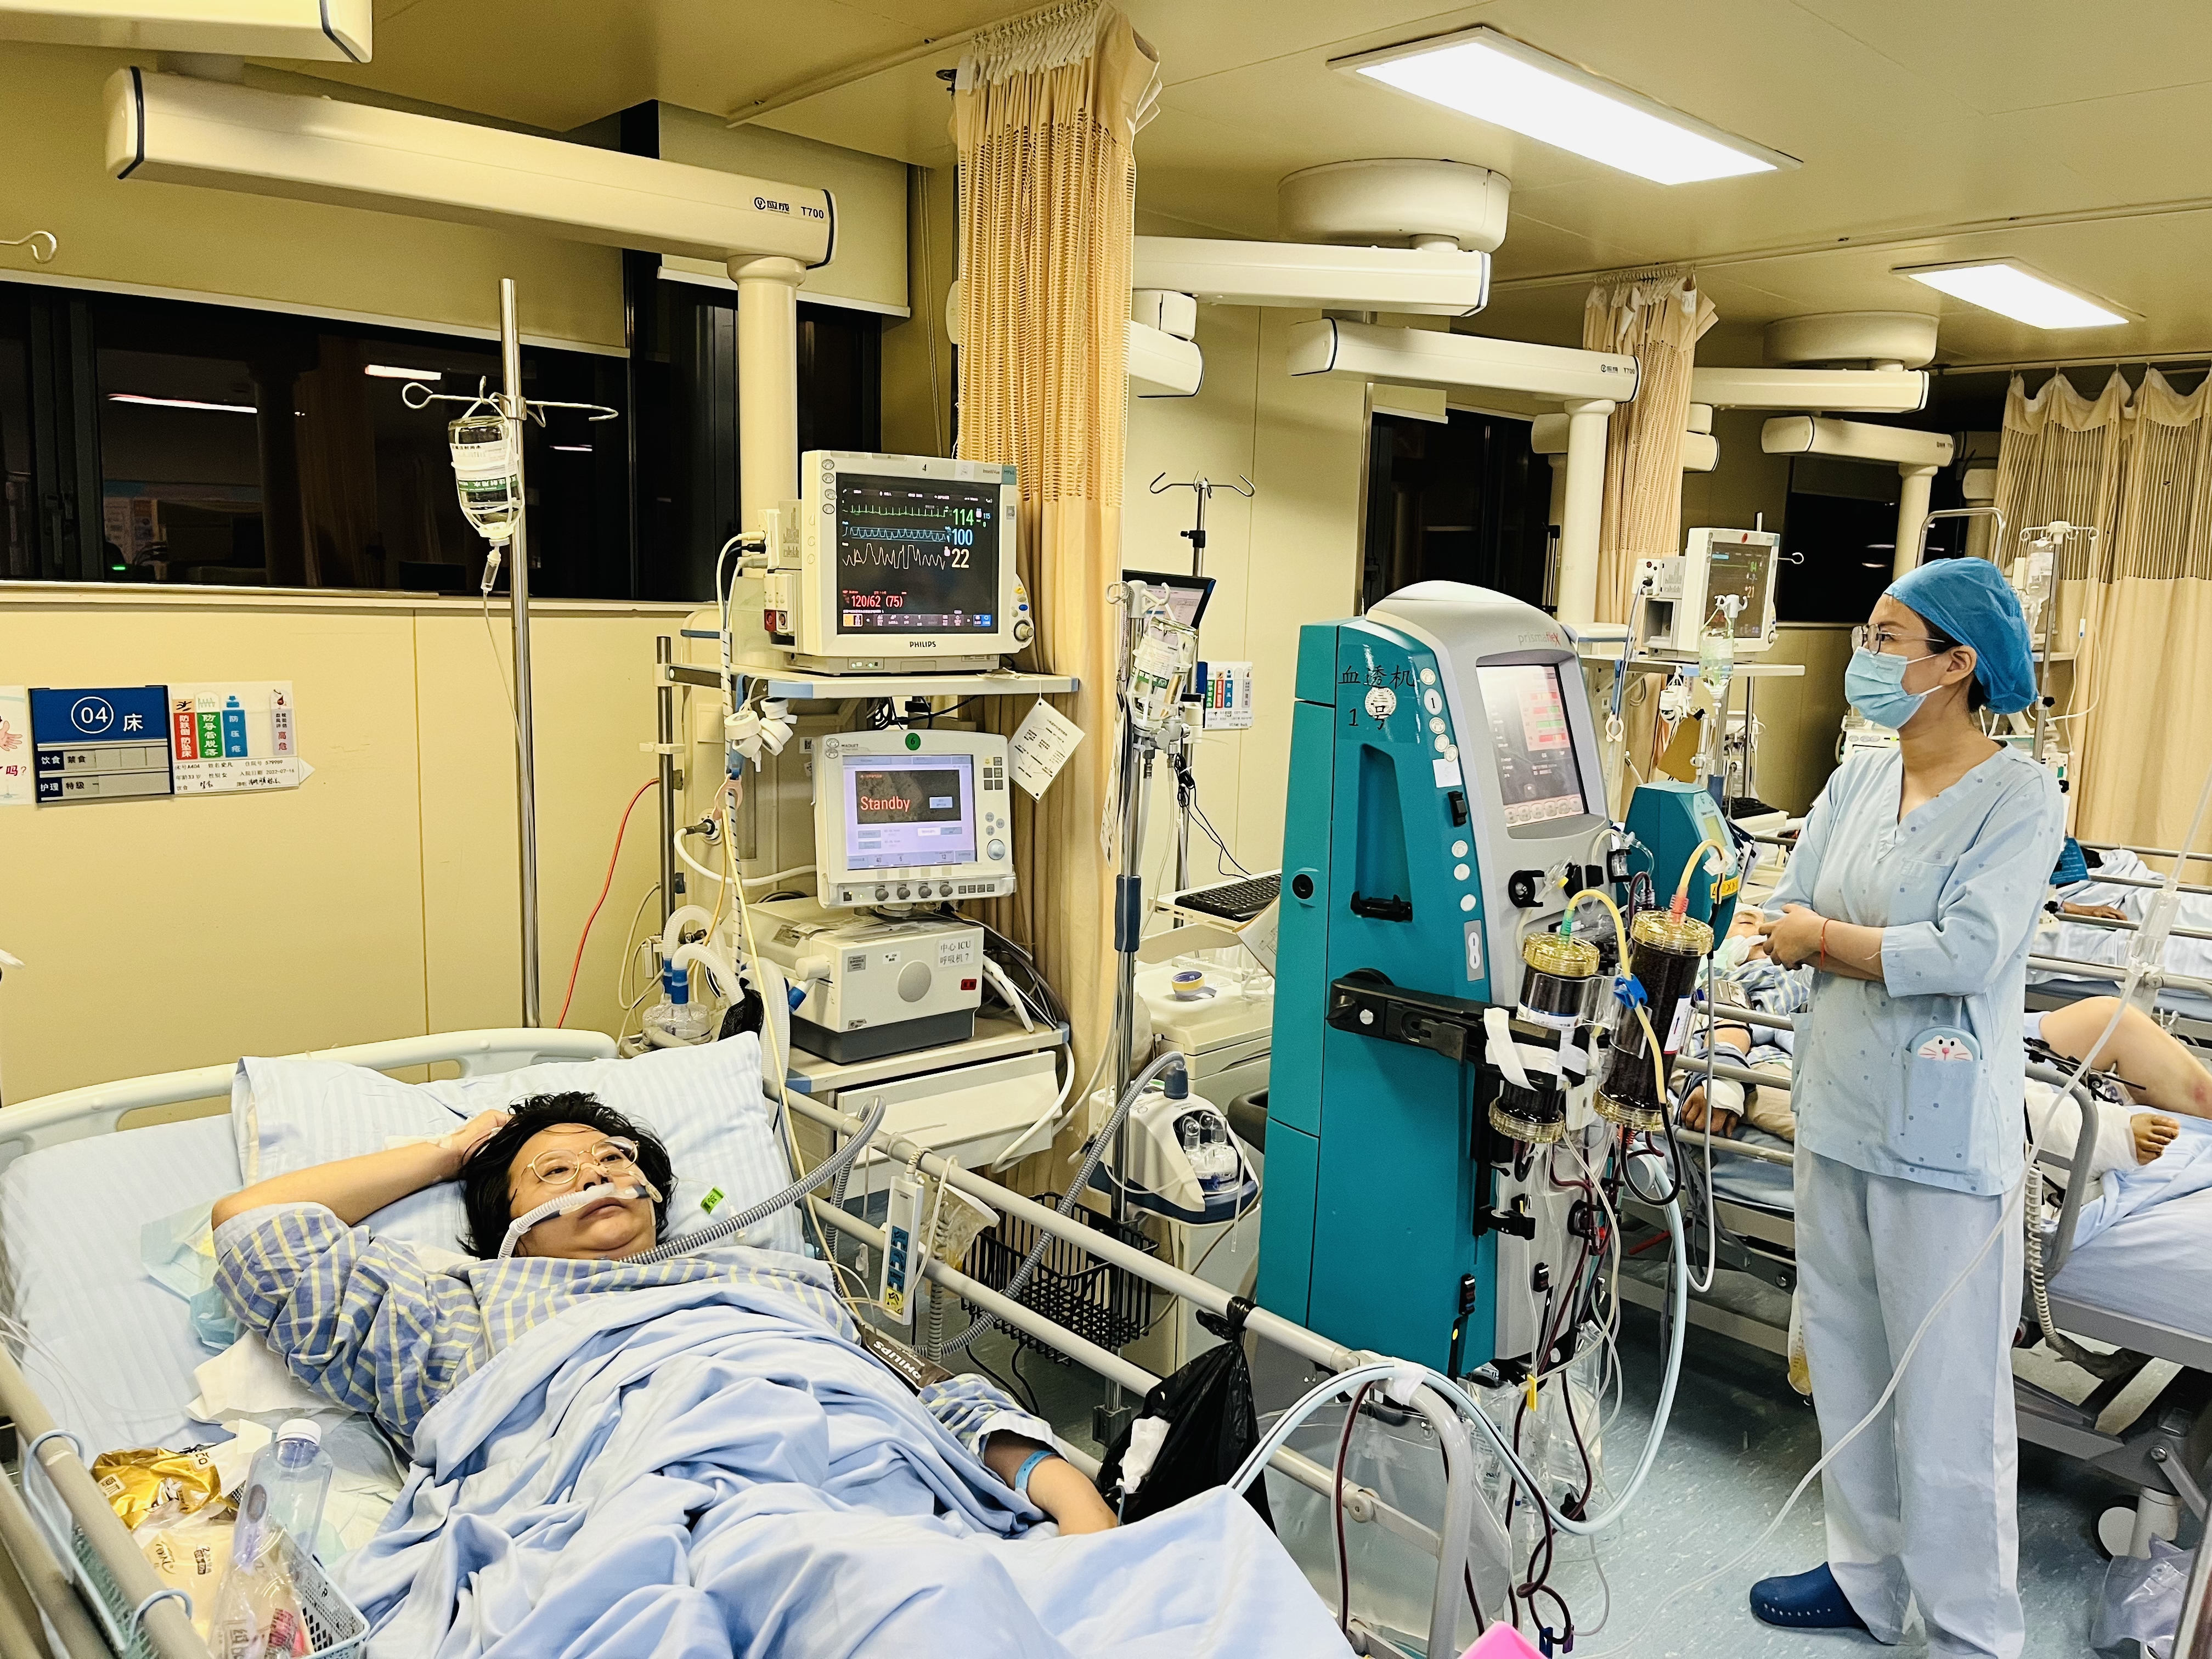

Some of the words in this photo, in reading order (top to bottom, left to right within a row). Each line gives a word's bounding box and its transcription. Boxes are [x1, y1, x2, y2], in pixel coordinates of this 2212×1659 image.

[801, 206, 824, 219] T700
[922, 464, 927, 472] 4
[952, 508, 974, 526] 114
[952, 528, 974, 546] 100
[951, 549, 970, 569] 22
[851, 595, 881, 608] 120/62
[885, 595, 904, 608] (75)
[1518, 631, 1561, 648] prismaflex
[1338, 664, 1415, 690] 血透机
[81, 707, 108, 724] 04
[123, 713, 143, 732] 床
[911, 737, 915, 745] 6
[41, 755, 60, 765] 饮食
[40, 782, 59, 792] 护理
[860, 795, 911, 812] Standby
[940, 943, 956, 953] 中心
[958, 940, 971, 950] ICU
[940, 953, 963, 965] 呼吸机
[965, 953, 969, 961] 7
[873, 1340, 922, 1380] PHILIPS
